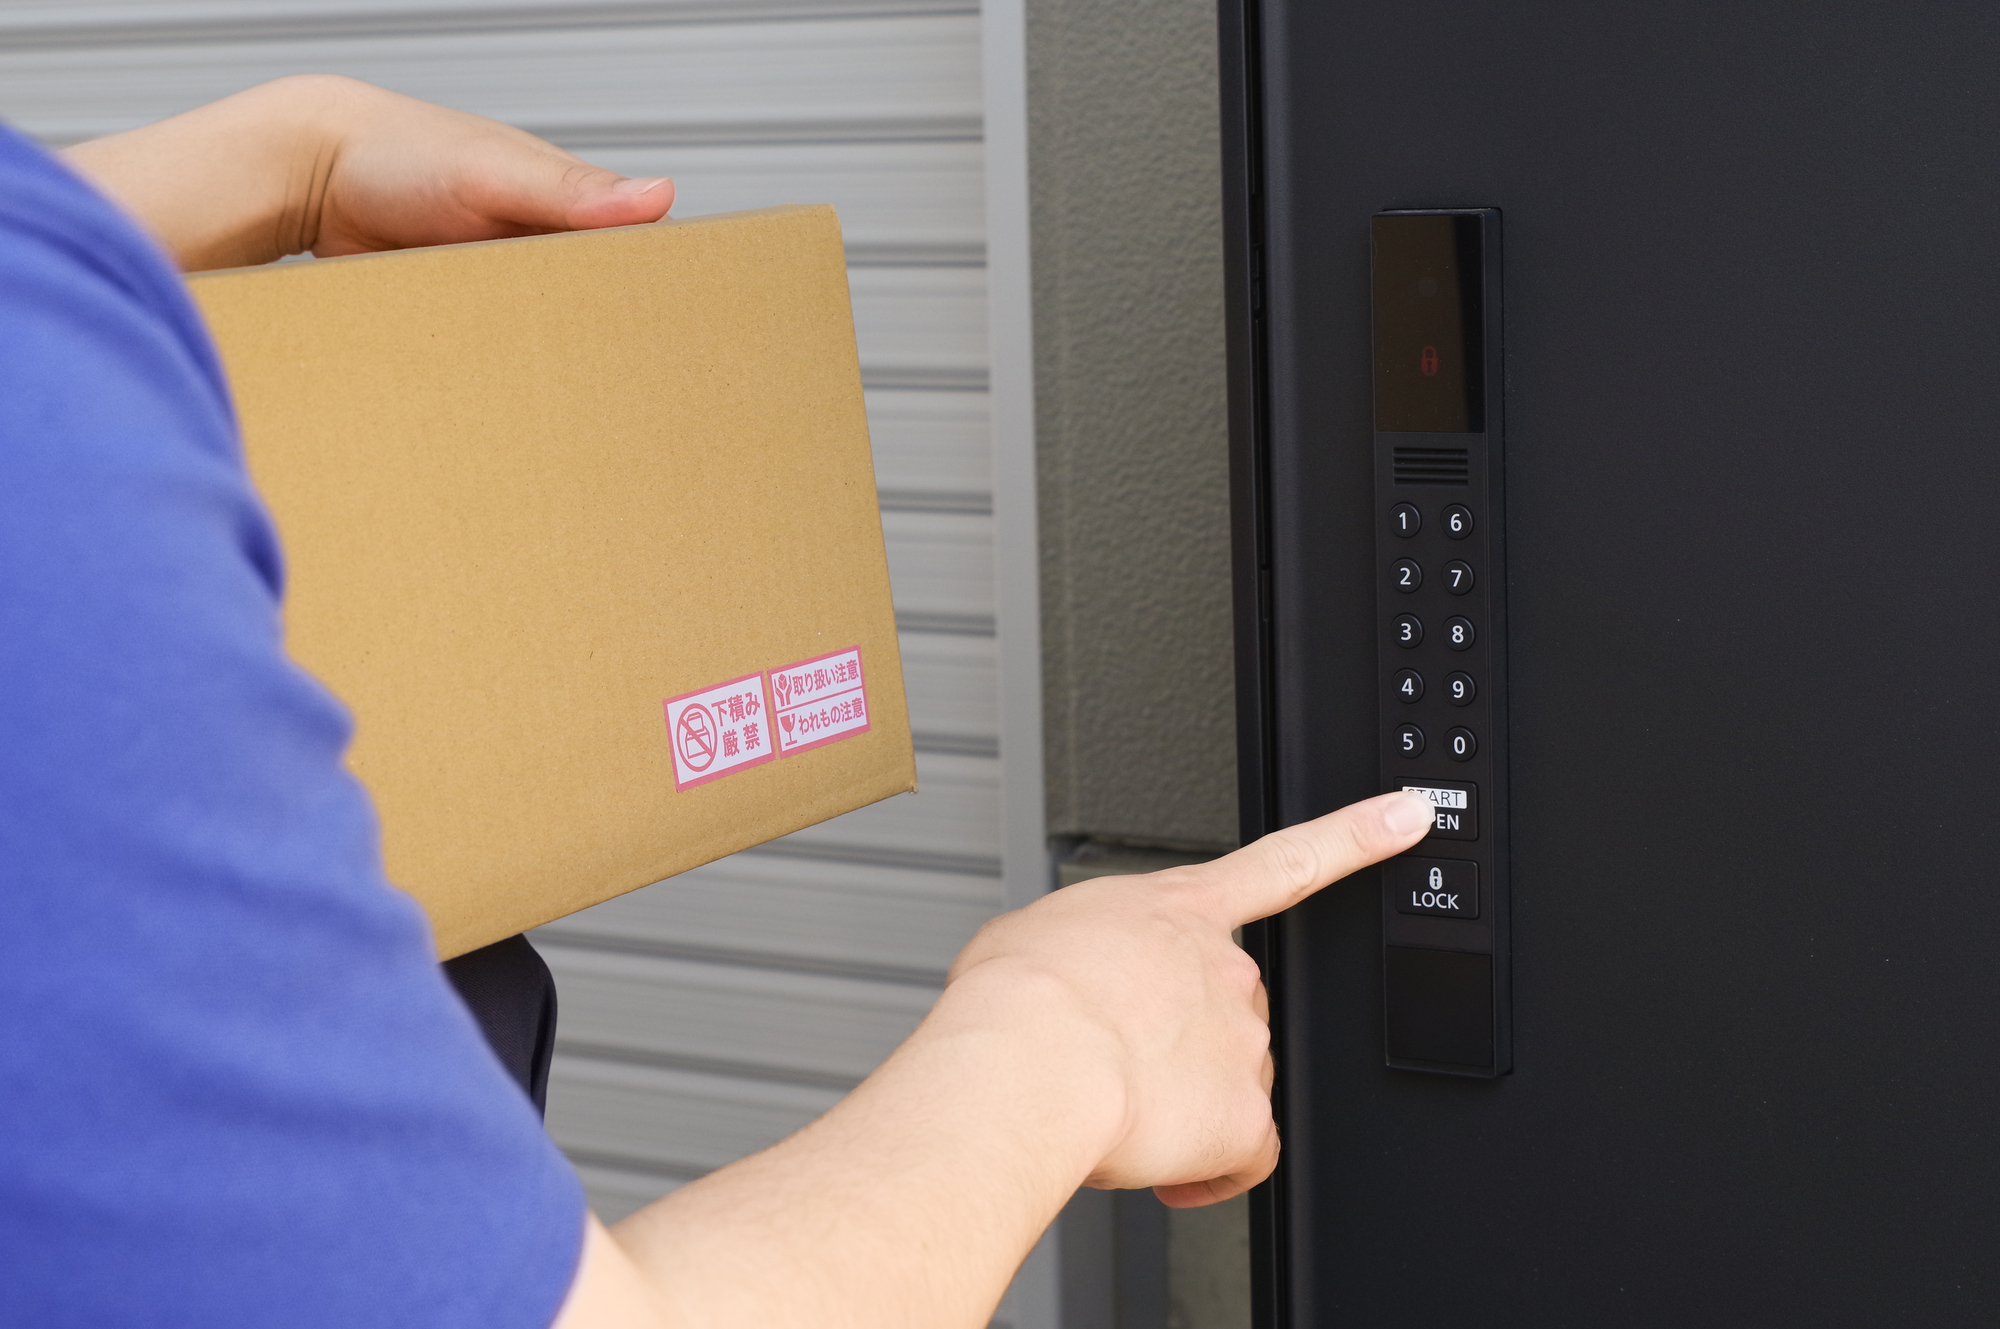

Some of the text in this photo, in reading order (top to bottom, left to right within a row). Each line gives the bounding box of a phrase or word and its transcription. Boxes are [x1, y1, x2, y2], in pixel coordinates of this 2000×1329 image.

[1398, 512, 1407, 530] 1
[1450, 513, 1462, 532] 6
[1400, 567, 1411, 585] 2
[1451, 569, 1462, 587] 7
[1401, 623, 1412, 641] 3
[1451, 625, 1464, 643] 8
[792, 660, 859, 695] 取り扱い注意
[1401, 678, 1414, 696] 4
[1452, 680, 1464, 699] 9
[711, 692, 760, 726] 下積み
[798, 698, 864, 734] われもの注意
[722, 722, 760, 757] 厳禁
[1403, 733, 1414, 751] 5
[1453, 736, 1466, 754] 0
[1407, 788, 1462, 807] ART
[1436, 813, 1460, 831] EN
[1412, 890, 1460, 910] LOCK
